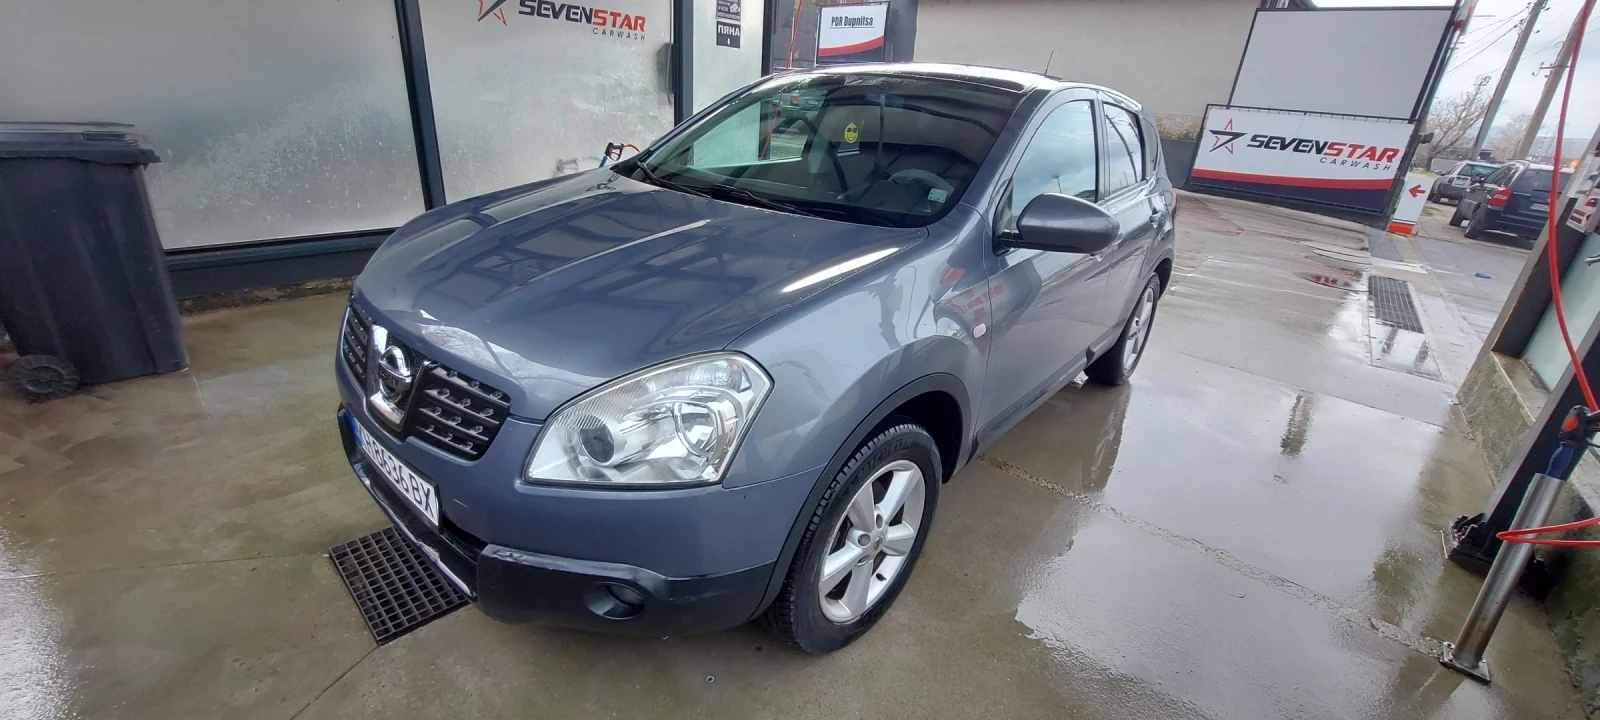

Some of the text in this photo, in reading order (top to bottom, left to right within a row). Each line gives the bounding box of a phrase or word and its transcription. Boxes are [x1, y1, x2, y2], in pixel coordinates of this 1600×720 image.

[518, 0, 646, 32] SEVENSTAR
[831, 16, 874, 27] PDR Dupnitsa
[592, 27, 646, 42] CARWASH
[718, 24, 740, 36] ПЯНА
[1246, 134, 1400, 163] SEVENSTAR
[1319, 156, 1392, 172] CARWASH
